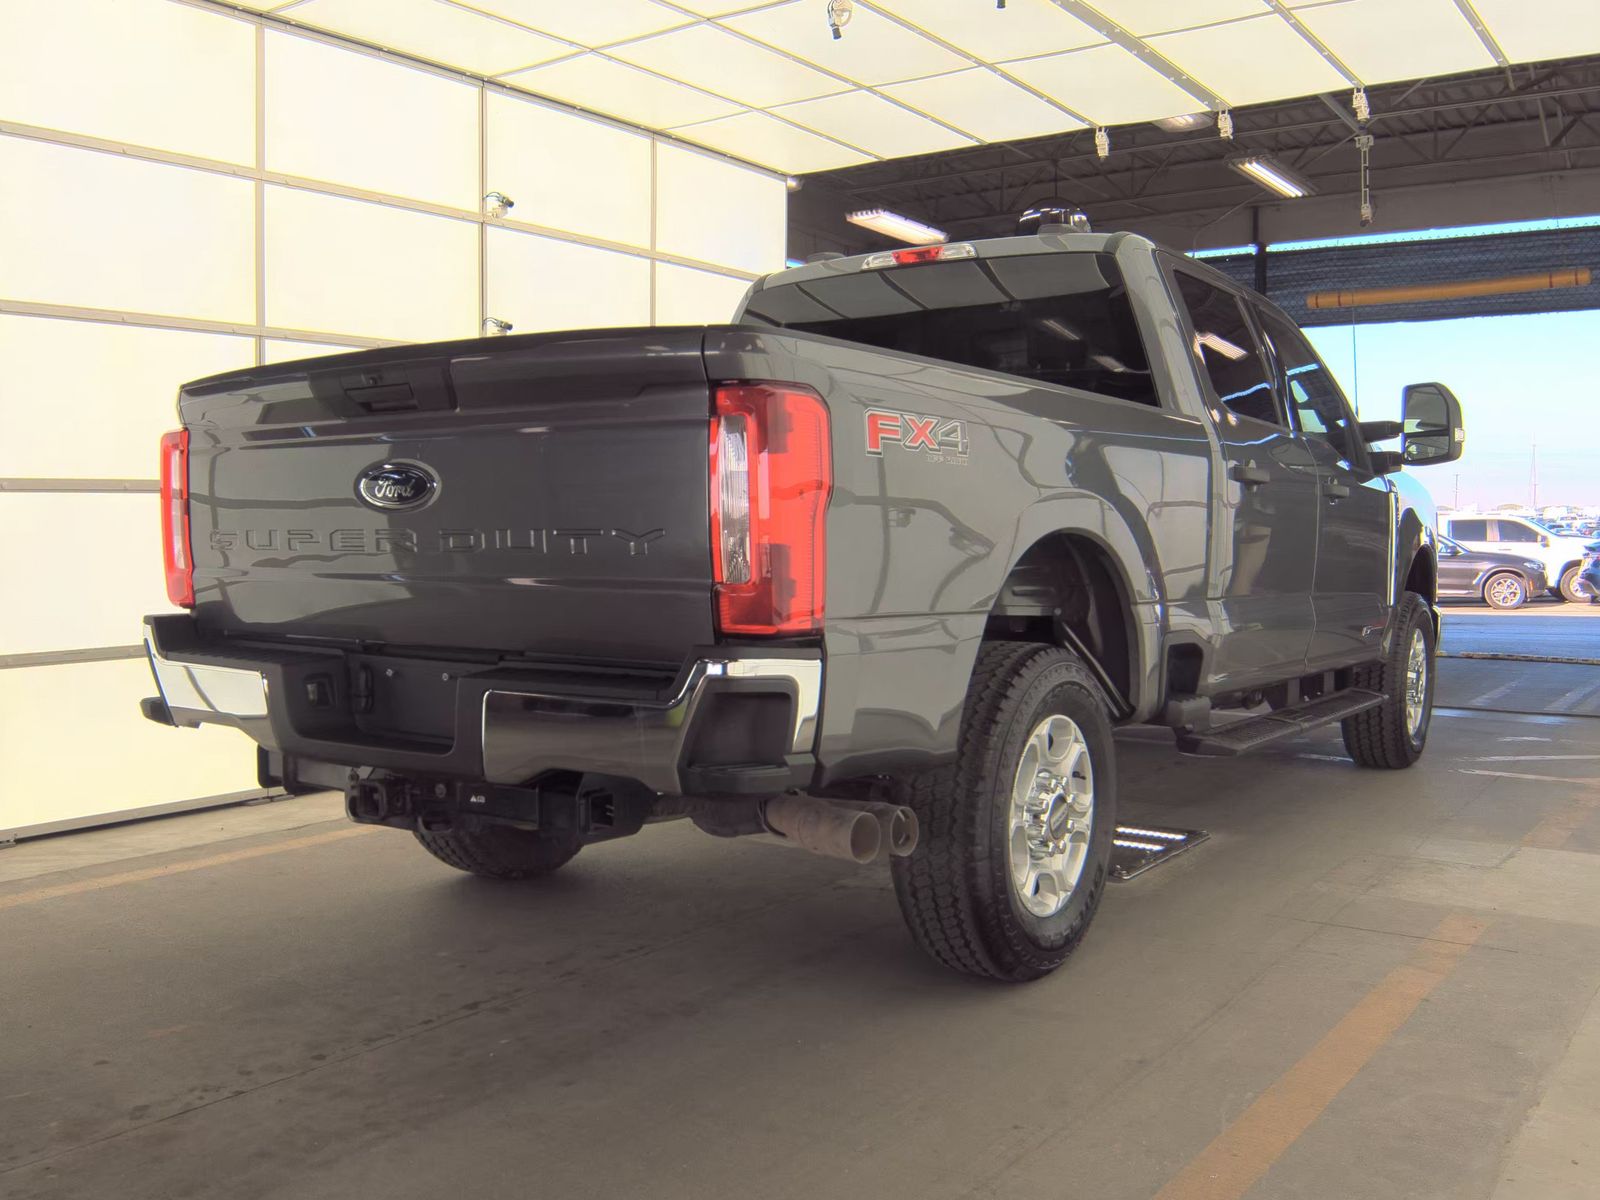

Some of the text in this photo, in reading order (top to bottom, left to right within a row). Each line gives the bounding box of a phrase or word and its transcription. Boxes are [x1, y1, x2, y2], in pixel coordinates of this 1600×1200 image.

[864, 407, 969, 457] FX4
[374, 476, 416, 498] Ford
[210, 527, 666, 556] SUPER DUTY
